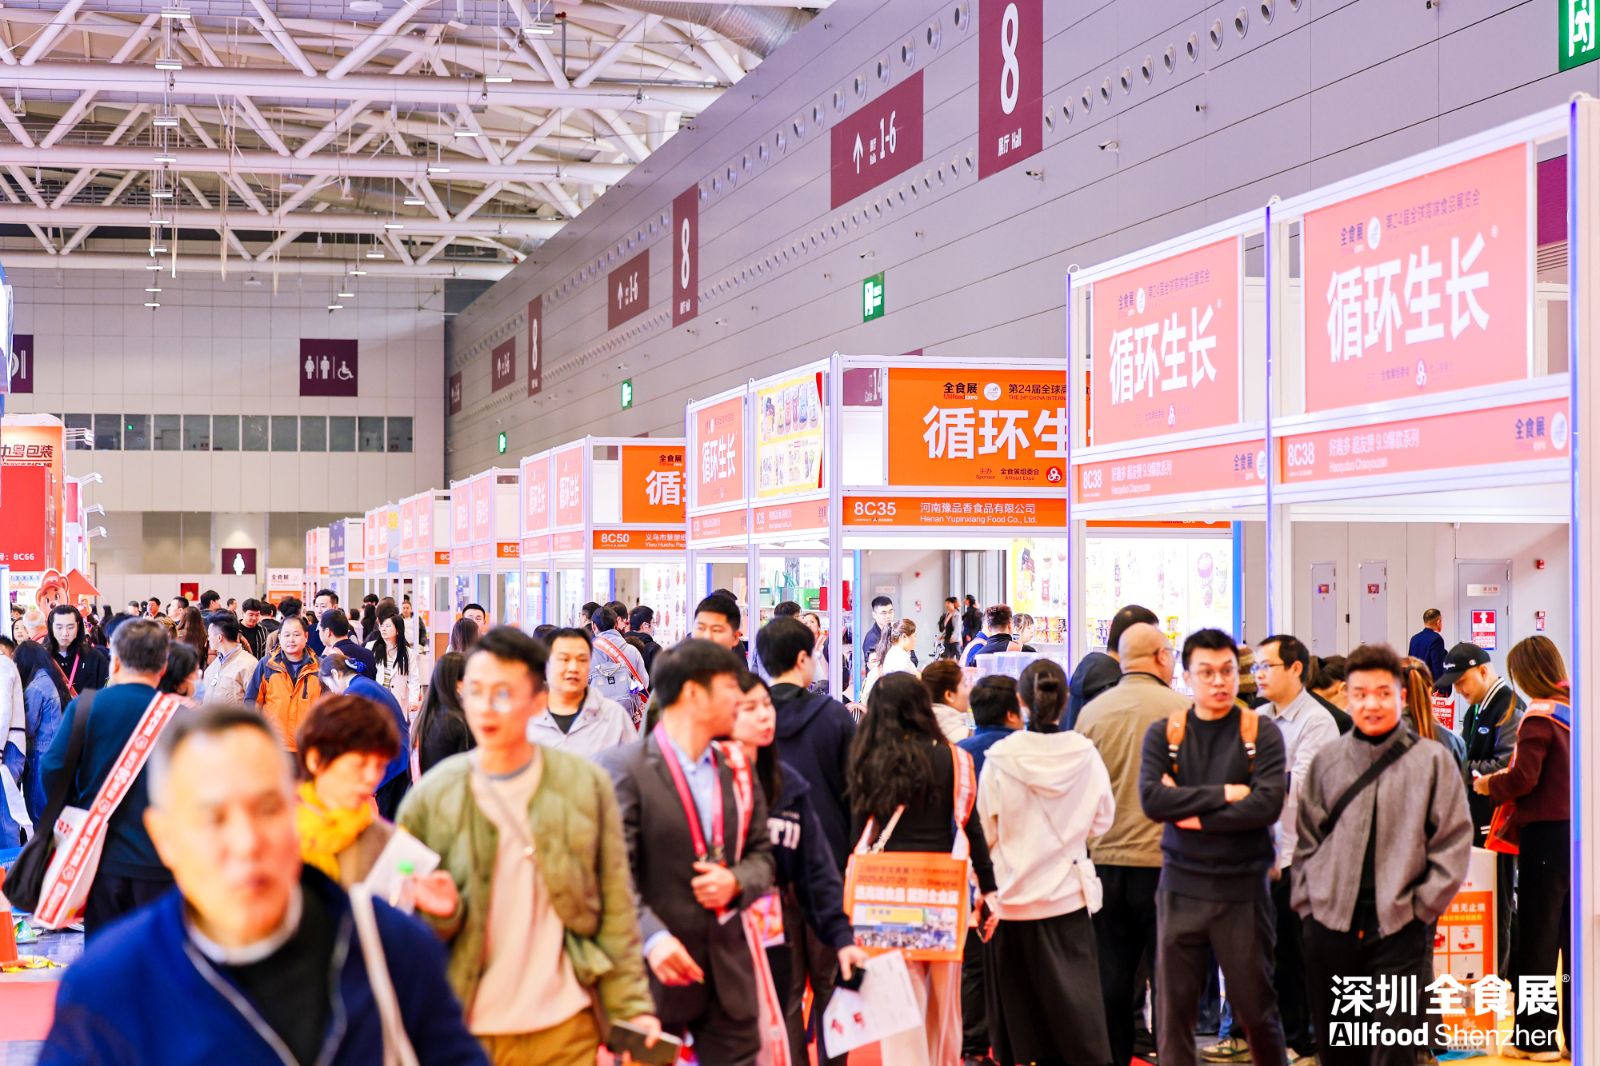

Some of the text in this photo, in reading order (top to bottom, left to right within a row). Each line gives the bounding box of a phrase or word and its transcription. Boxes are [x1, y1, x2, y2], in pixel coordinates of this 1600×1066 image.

[1000, 3, 1020, 115] 8
[880, 110, 896, 160] 1-6
[998, 128, 1022, 157] 展厅 Hall
[681, 218, 690, 290] 8
[1326, 232, 1490, 363] 循环生长
[532, 318, 538, 370] 8
[1109, 304, 1217, 406] 循环生长
[944, 382, 978, 394] 全食展
[1515, 416, 1545, 440] 全食展
[659, 454, 682, 462] 全食展
[702, 432, 736, 484] 循环生长
[1288, 442, 1315, 466] 8C38
[854, 501, 896, 516] 8C35
[920, 502, 1036, 514] 河南豫品香食品有限公司
[946, 516, 985, 524] Yupinxiang
[601, 534, 630, 543] 8C50
[13, 553, 34, 561] 8C66
